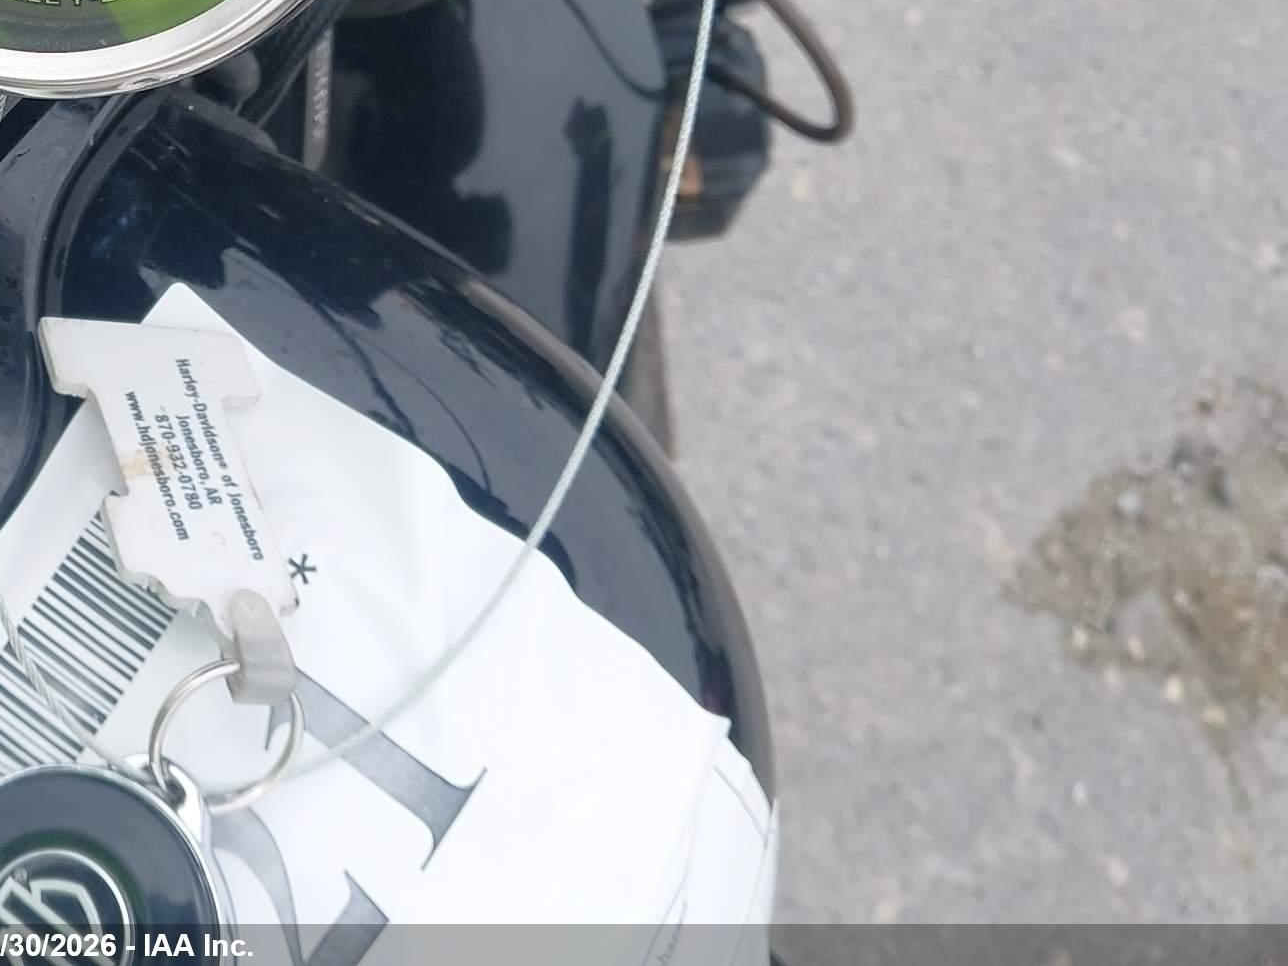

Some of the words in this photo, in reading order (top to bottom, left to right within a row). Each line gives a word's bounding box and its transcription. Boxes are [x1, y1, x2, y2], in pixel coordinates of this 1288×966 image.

[125, 391, 189, 541] www.hdjonesboro.com
[154, 413, 203, 510] 870-932-0780
[176, 414, 210, 486] Jonesboro,
[205, 487, 223, 506] AR
[222, 474, 238, 490] of
[227, 491, 264, 561] Jonesboro
